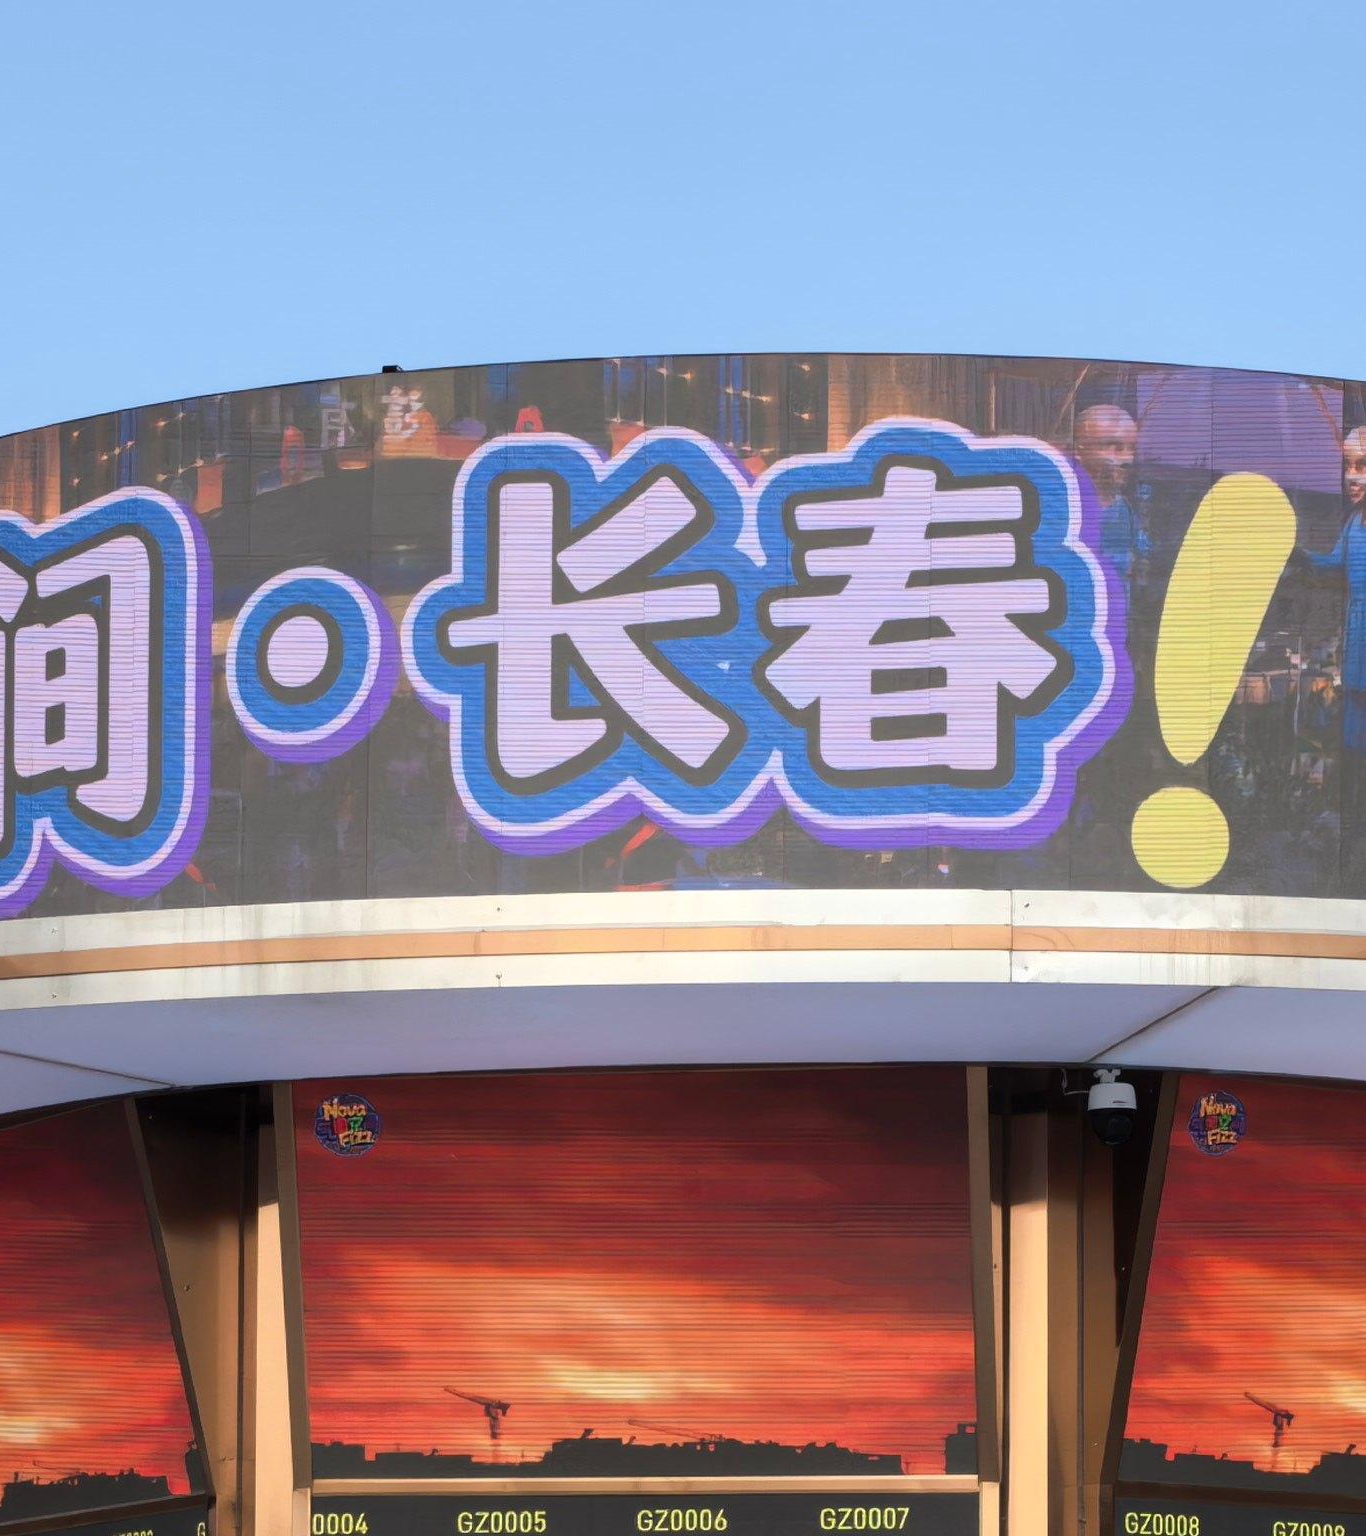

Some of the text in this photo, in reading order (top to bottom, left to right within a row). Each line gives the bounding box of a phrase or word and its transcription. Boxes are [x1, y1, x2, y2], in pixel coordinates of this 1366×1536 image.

[457, 1510, 547, 1534] GZ0005
[636, 1508, 728, 1532] GZ0006
[819, 1507, 910, 1530] GZ0007
